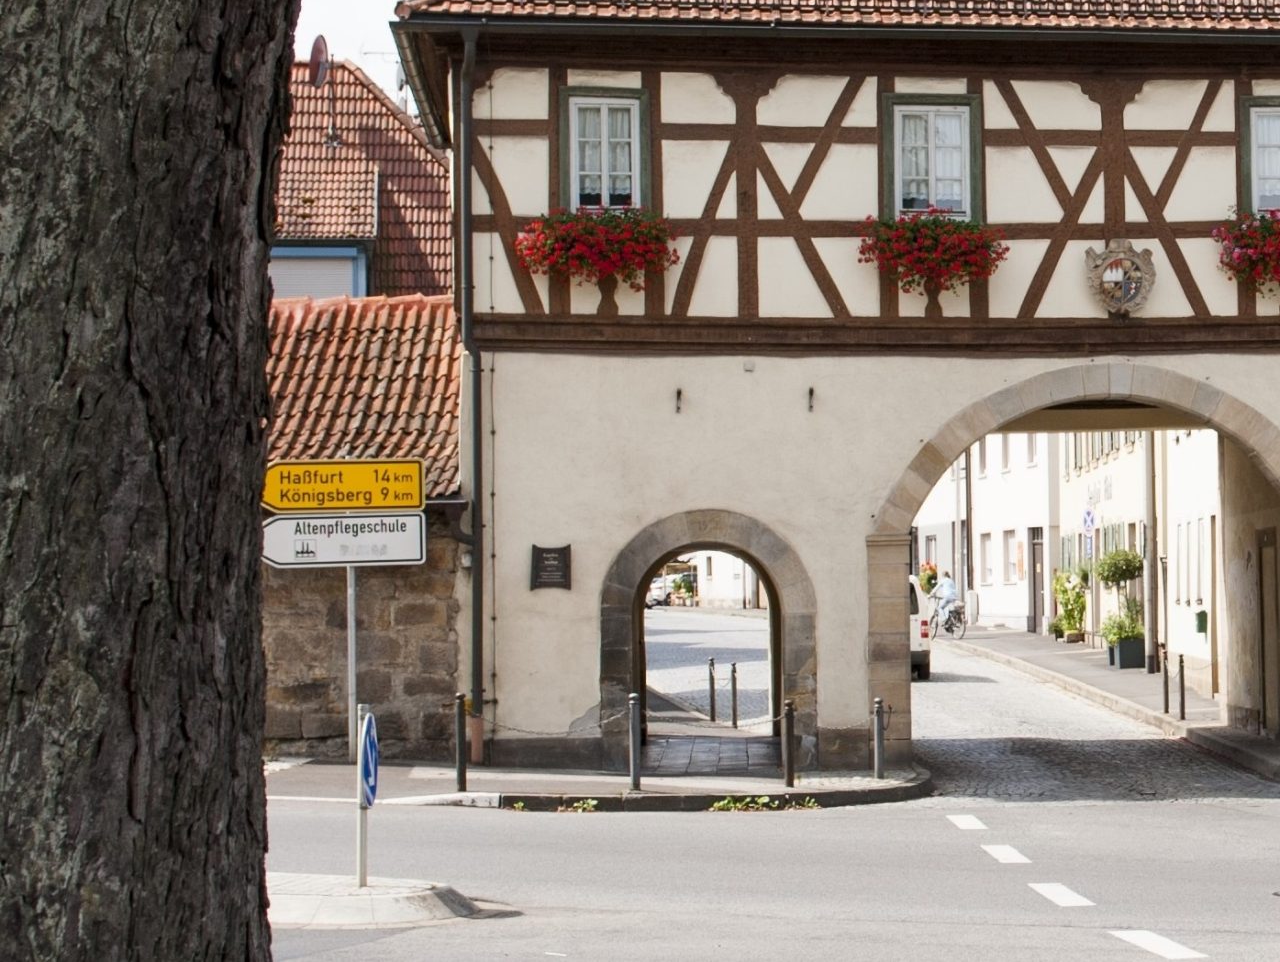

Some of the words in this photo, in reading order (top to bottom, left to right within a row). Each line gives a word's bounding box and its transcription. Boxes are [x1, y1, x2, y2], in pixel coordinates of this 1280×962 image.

[280, 470, 344, 485] Haßfurt
[373, 469, 391, 483] 14
[394, 472, 413, 483] km
[280, 488, 373, 505] Königsberg
[381, 487, 390, 501] 9
[394, 490, 413, 501] km
[294, 519, 407, 537] Altenpflegeschule
